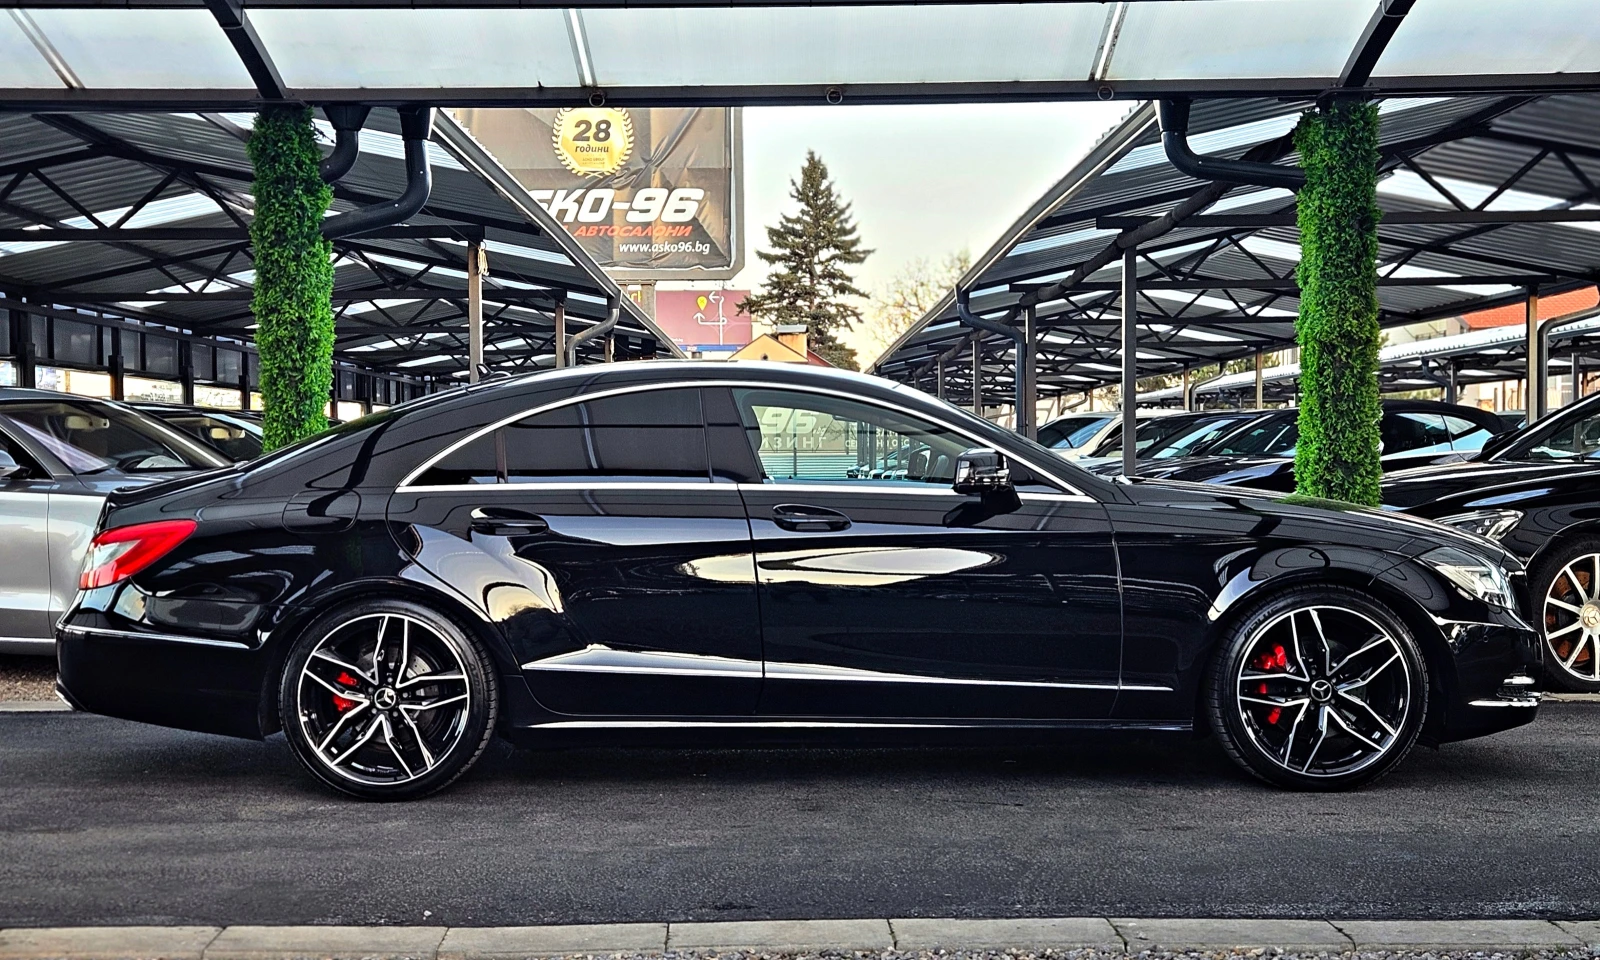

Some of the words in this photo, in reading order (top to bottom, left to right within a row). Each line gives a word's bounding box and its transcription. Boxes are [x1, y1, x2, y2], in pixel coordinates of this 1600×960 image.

[572, 119, 612, 142] 28
[575, 144, 609, 153] години
[573, 225, 693, 237] АВТОСАЛОНИ
[619, 241, 710, 255] www.asko96.bg
